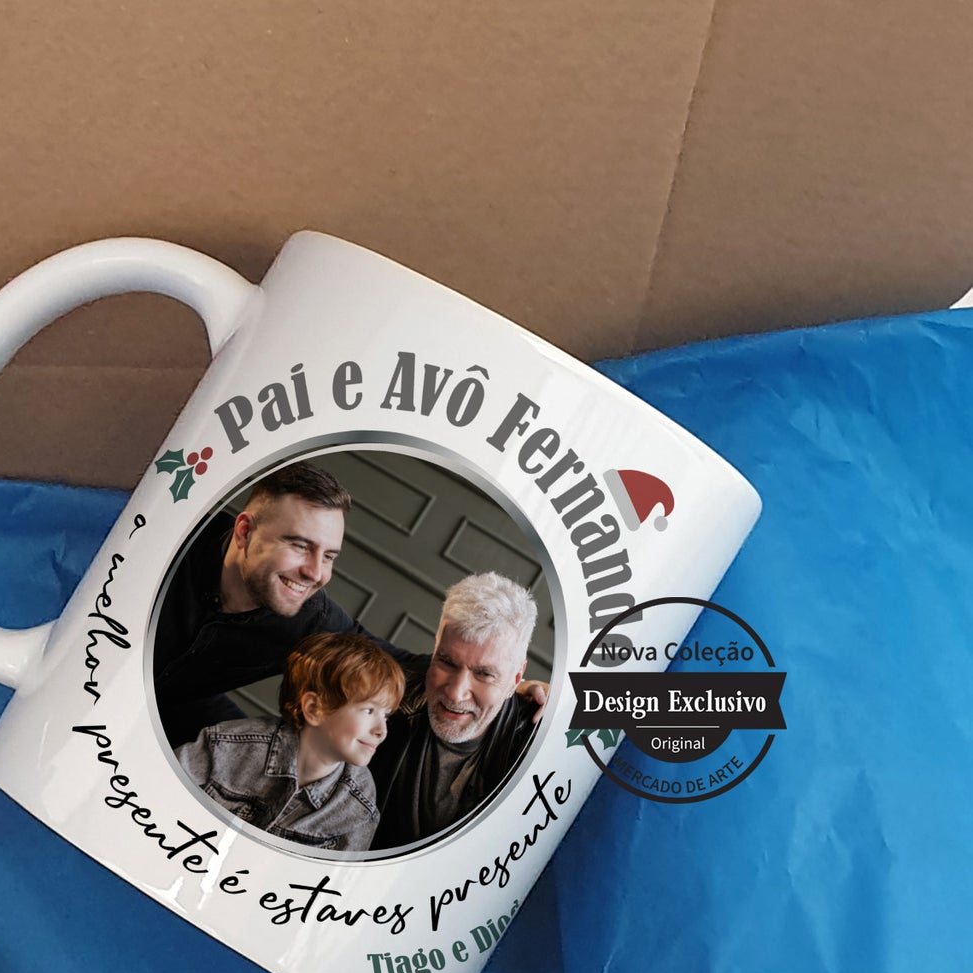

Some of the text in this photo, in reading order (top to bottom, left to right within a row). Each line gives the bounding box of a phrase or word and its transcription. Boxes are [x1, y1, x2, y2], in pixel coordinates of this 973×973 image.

[214, 363, 314, 454] Pai
[332, 361, 363, 410] e
[380, 351, 490, 427] Avô
[83, 553, 132, 706] melhor
[72, 725, 219, 874] presente
[430, 771, 572, 932] presente
[219, 869, 250, 895] é
[451, 940, 469, 963] e
